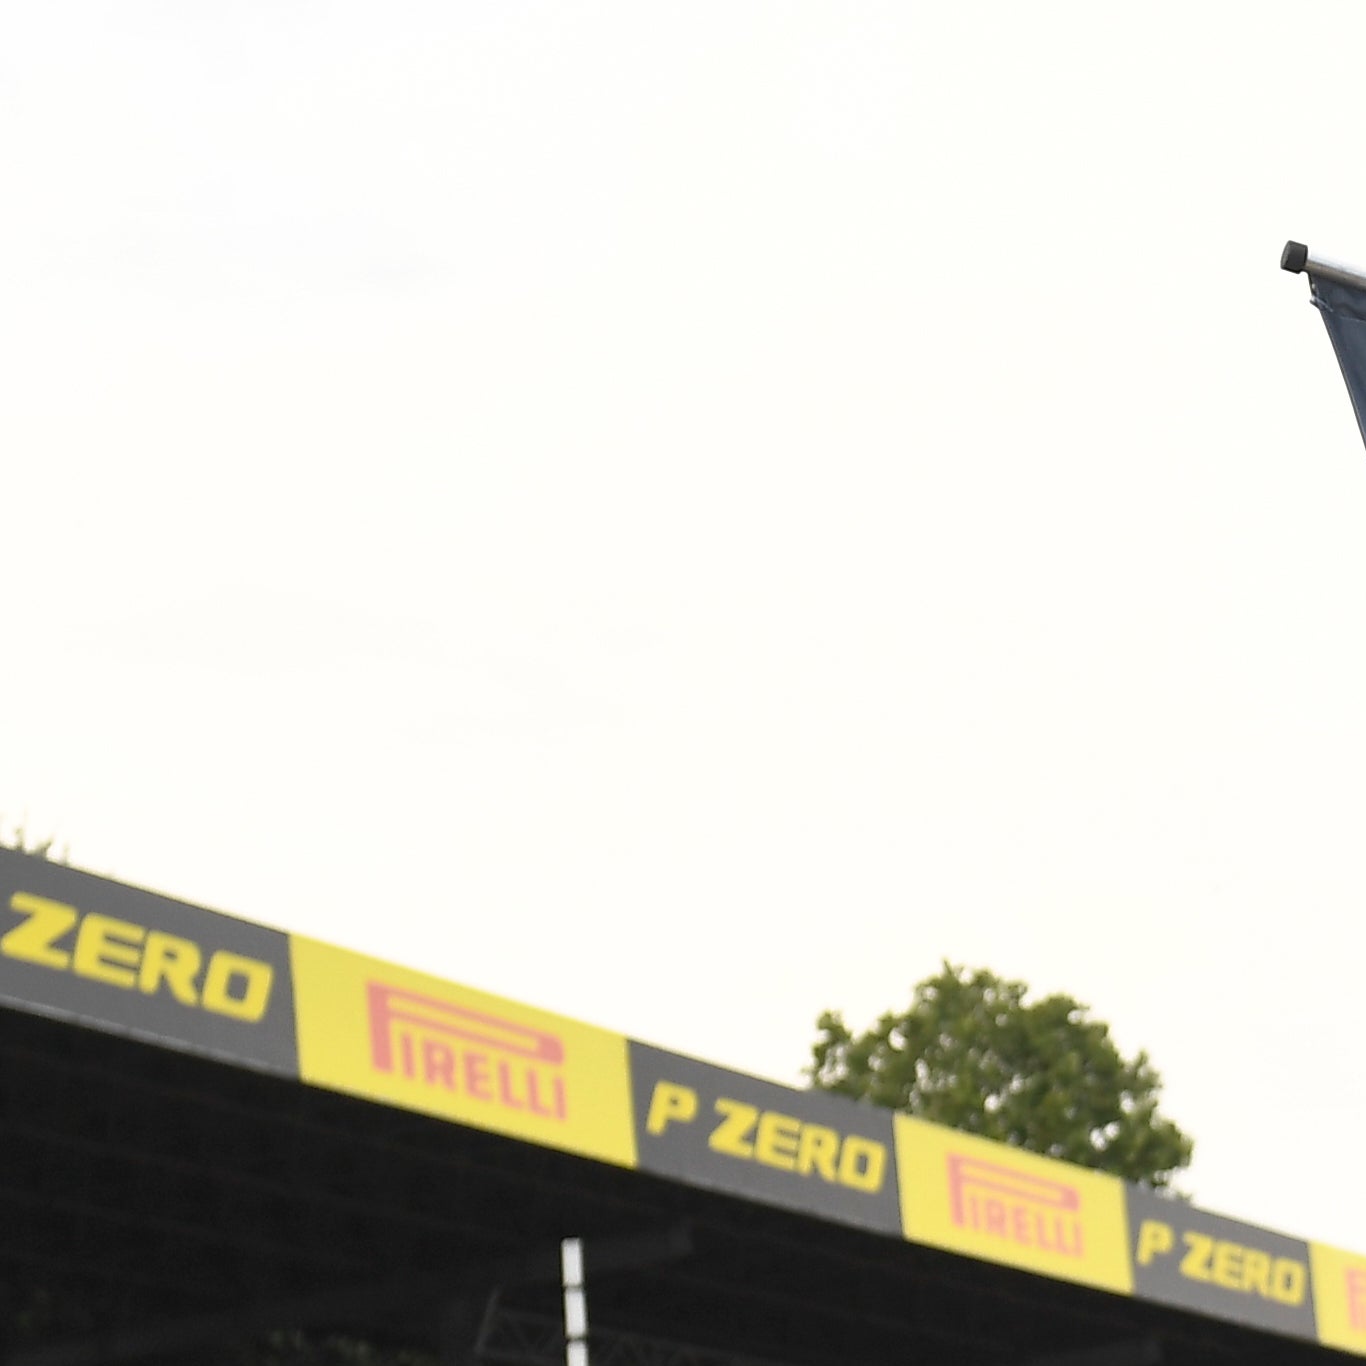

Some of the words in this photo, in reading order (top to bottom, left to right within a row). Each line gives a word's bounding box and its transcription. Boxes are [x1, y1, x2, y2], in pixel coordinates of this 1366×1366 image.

[0, 891, 274, 1022] ZERO
[365, 979, 567, 1123] PIRELLI
[646, 1079, 697, 1137] P
[708, 1100, 886, 1193] ZERO
[945, 1151, 1085, 1259] PIRELLI
[1136, 1220, 1173, 1266] P
[1180, 1231, 1306, 1306] ZERO
